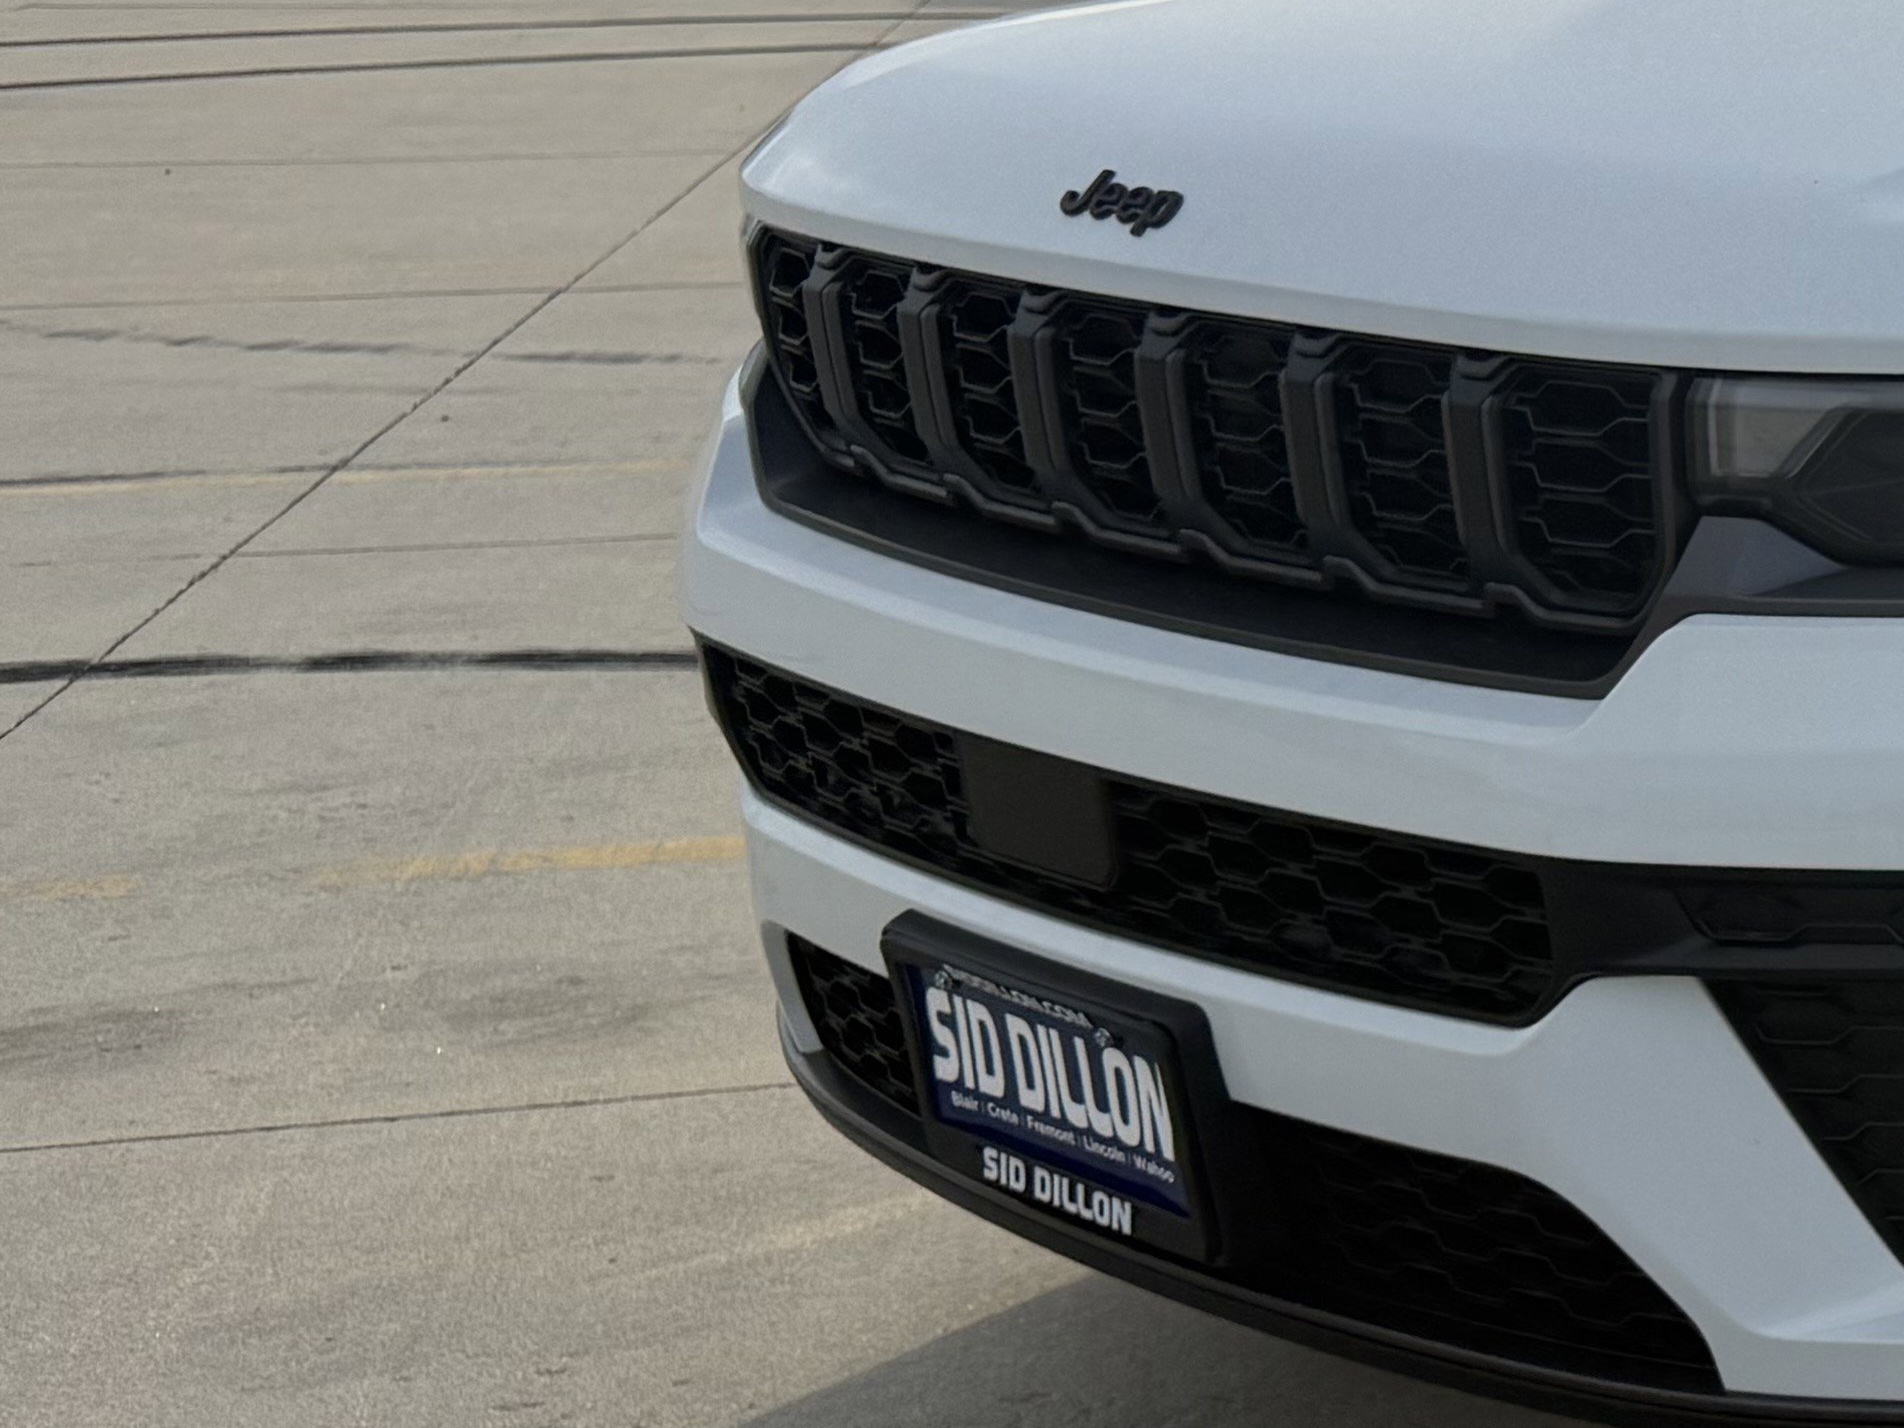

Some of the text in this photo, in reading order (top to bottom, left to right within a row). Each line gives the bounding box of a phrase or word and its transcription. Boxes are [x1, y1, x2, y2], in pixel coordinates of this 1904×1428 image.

[1060, 169, 1184, 238] Jeep
[925, 985, 1006, 1099] SID
[1004, 1012, 1176, 1163] DILLON
[982, 1145, 1133, 1237] SID DILLON
